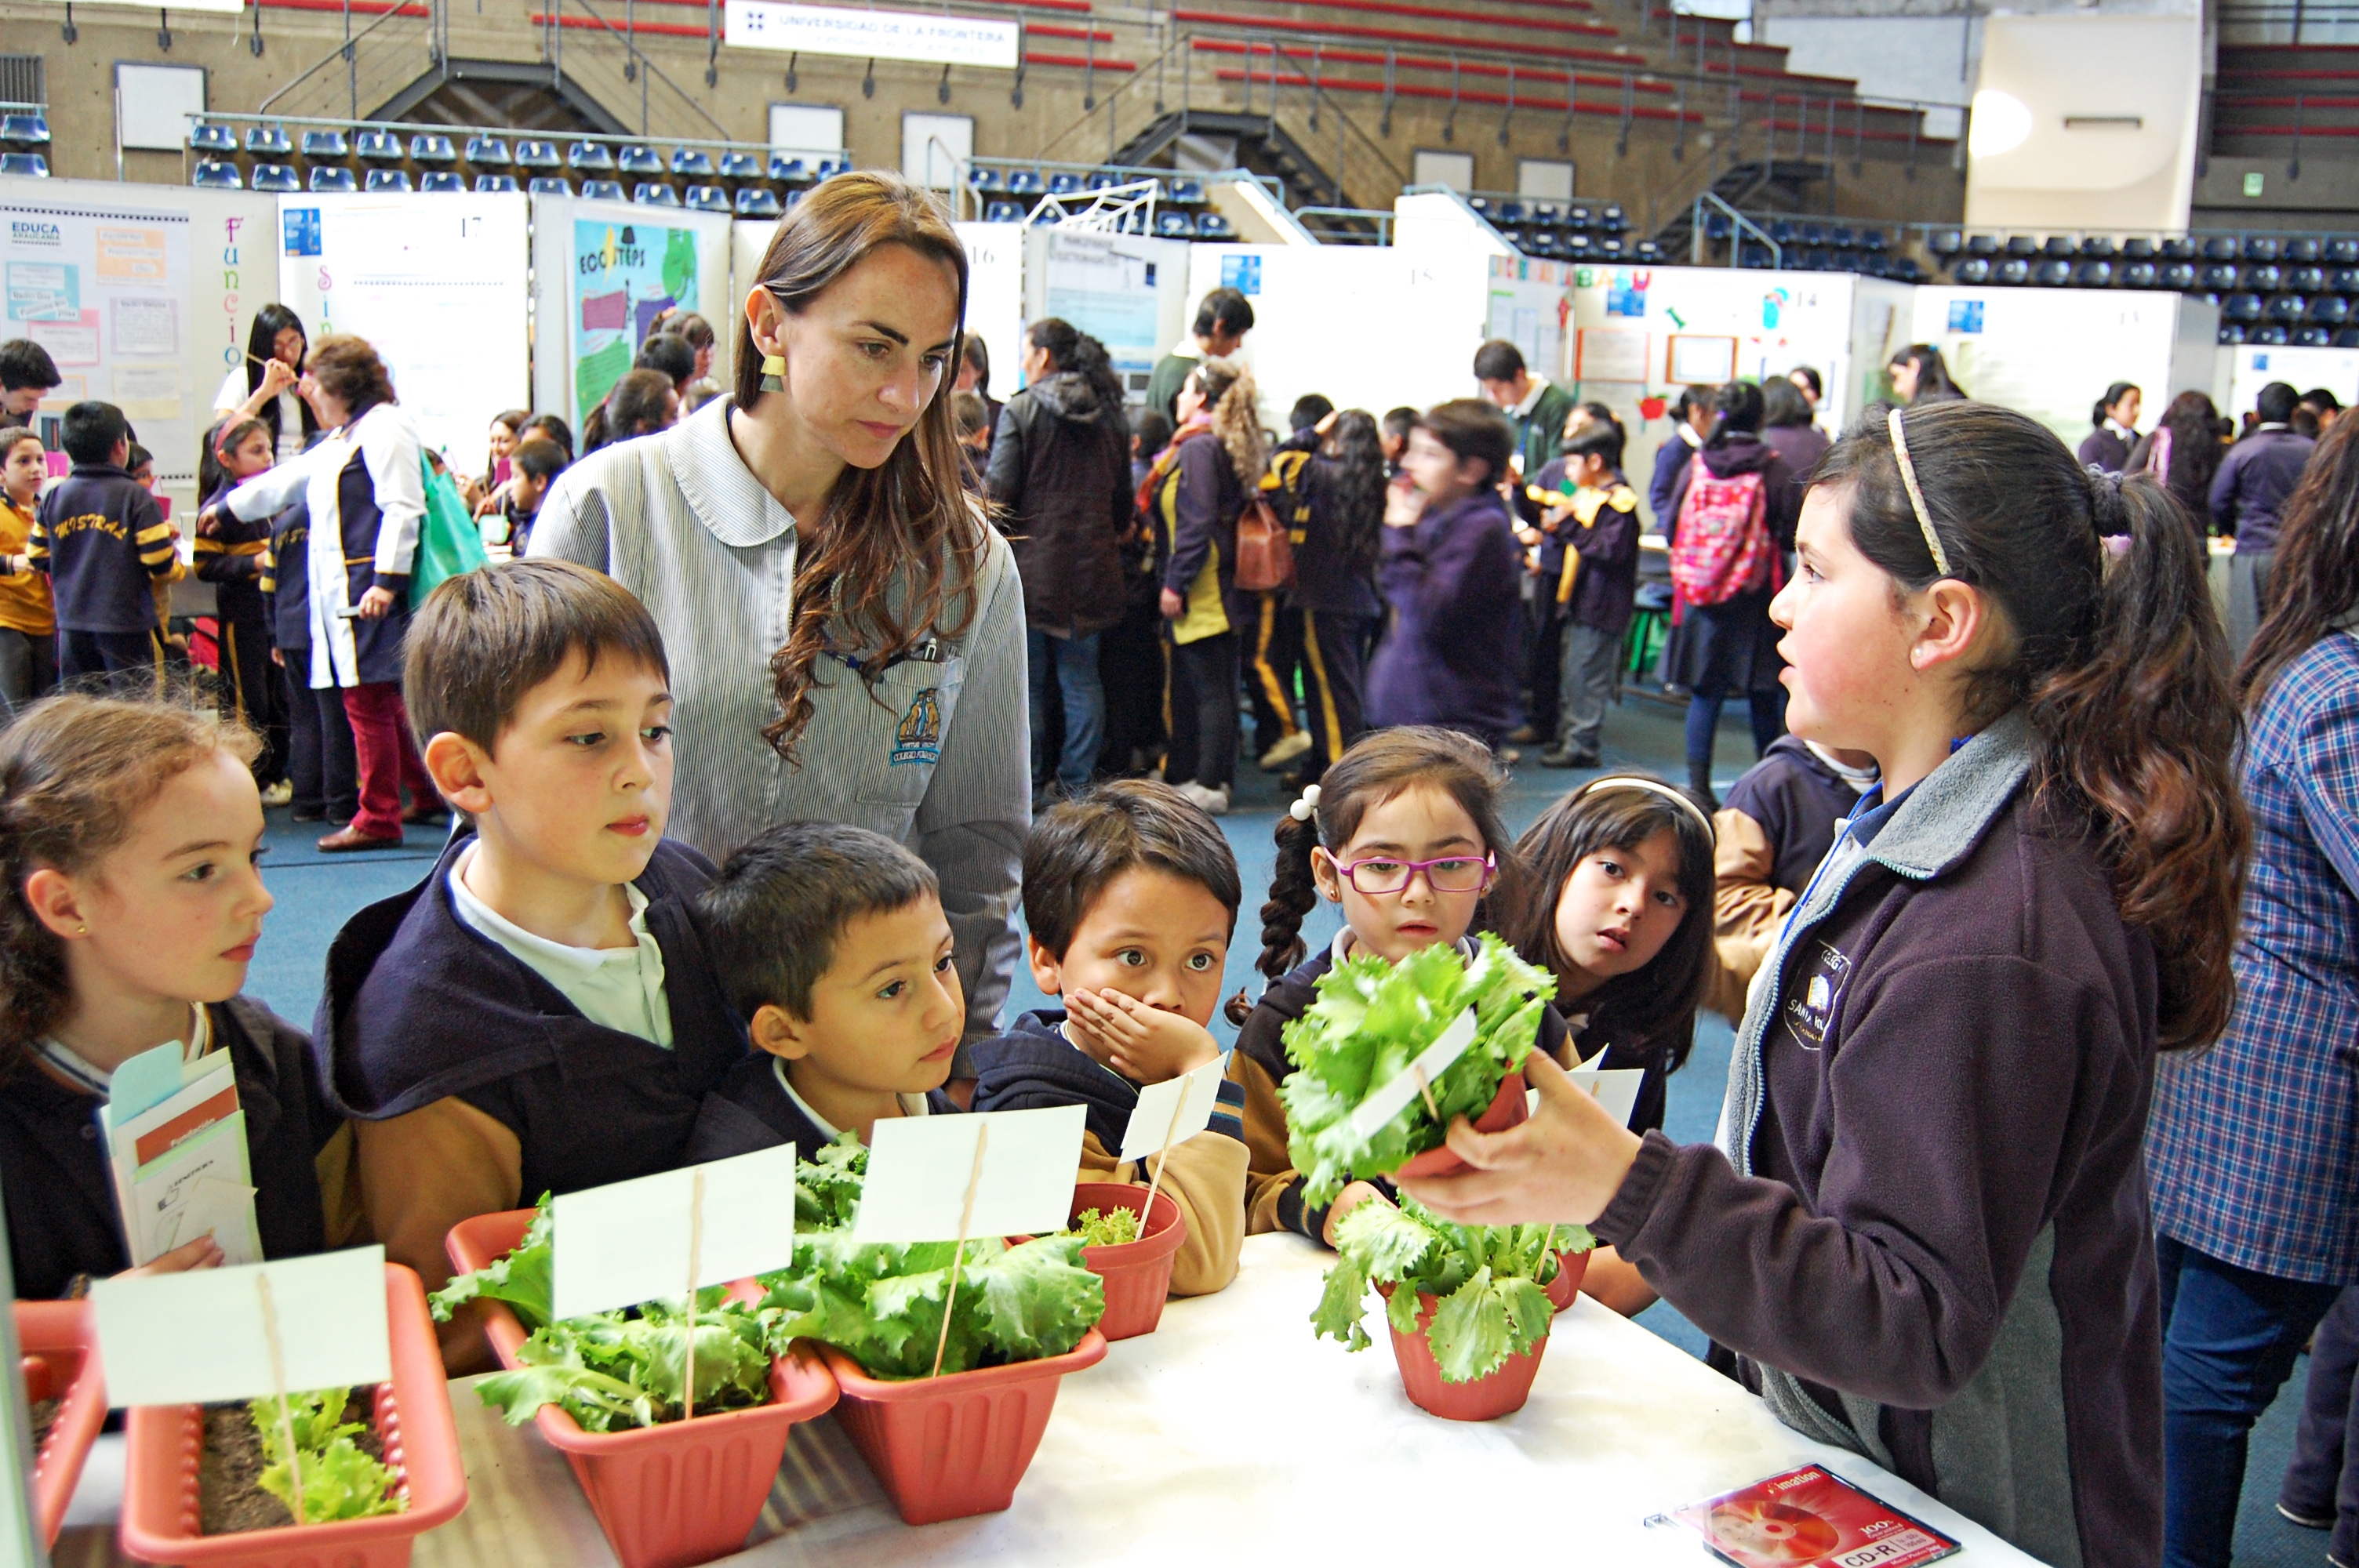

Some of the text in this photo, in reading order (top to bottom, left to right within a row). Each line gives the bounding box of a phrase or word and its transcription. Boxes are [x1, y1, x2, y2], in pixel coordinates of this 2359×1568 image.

[780, 15, 1005, 42] UNIVERSIDAD DE LA FRONTERA
[12, 221, 60, 234] EDUCA
[461, 216, 482, 238] 17
[972, 245, 994, 264] 16
[1774, 1472, 1821, 1491] imation
[1845, 1544, 1897, 1567] CD-R
